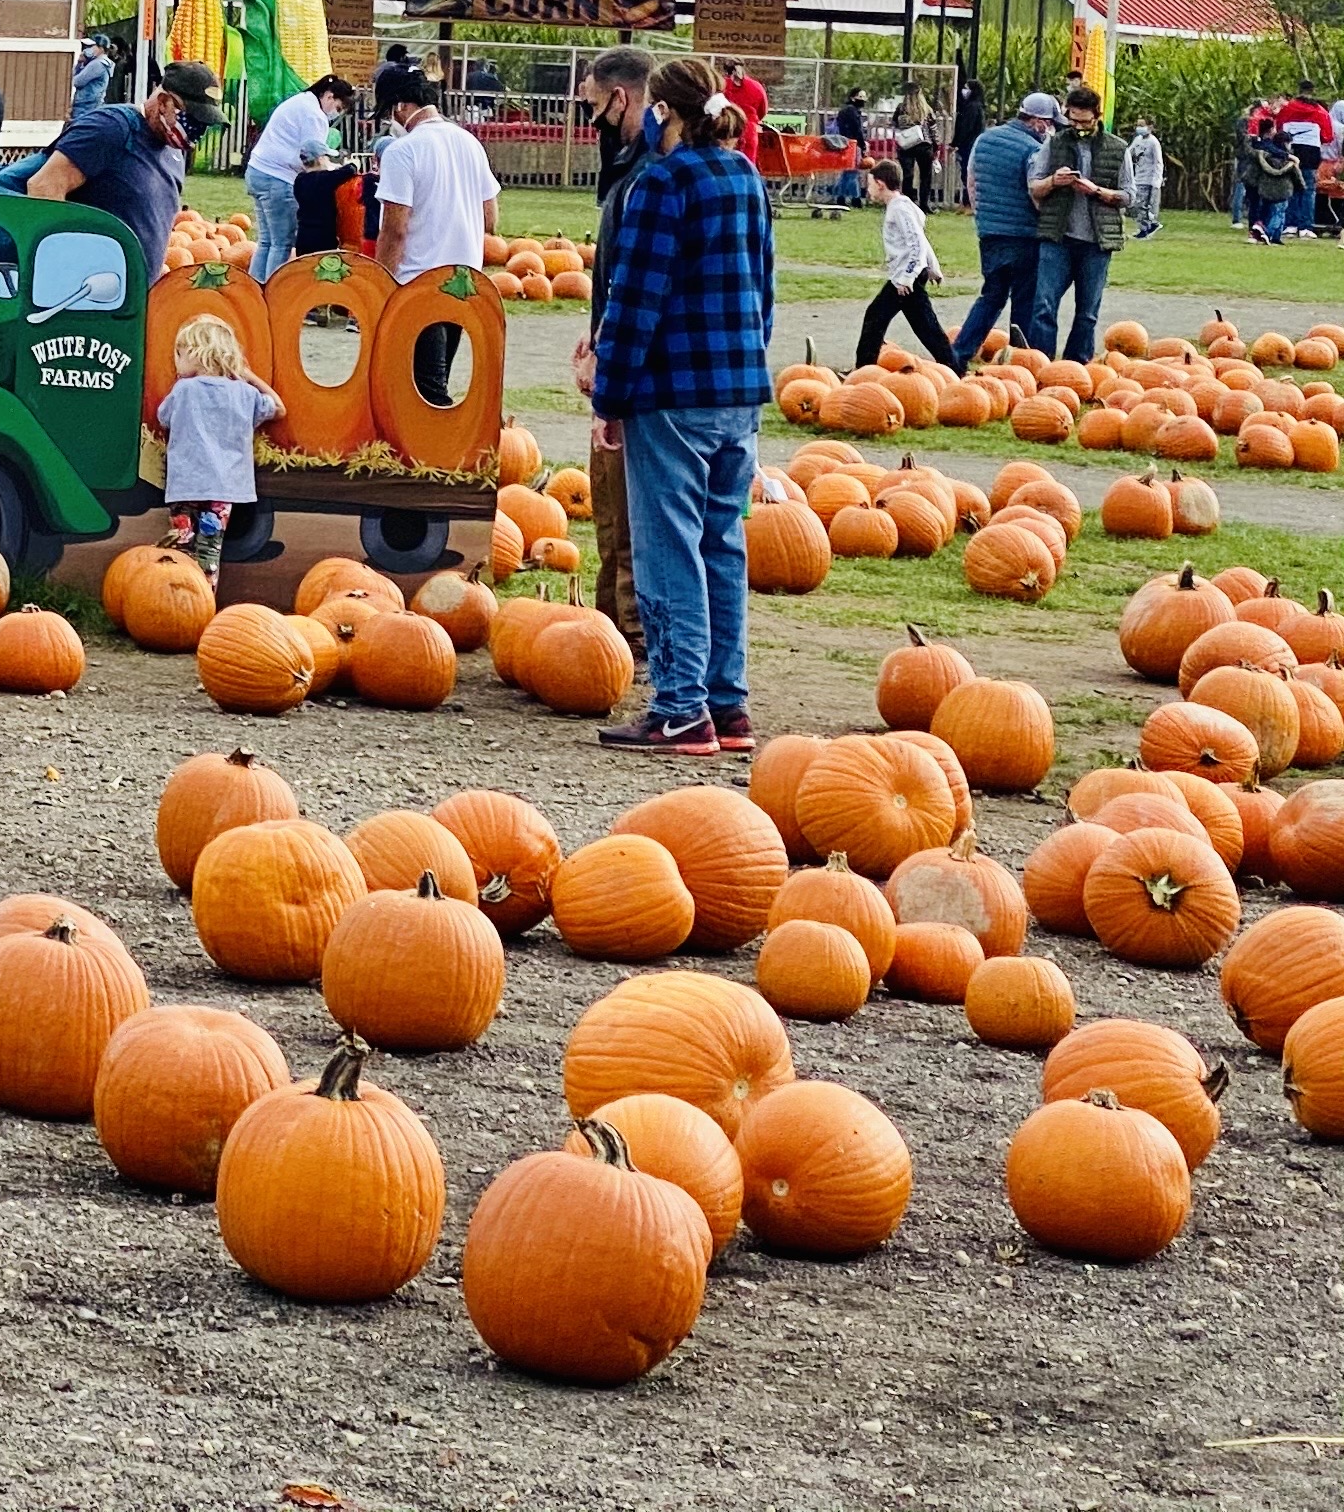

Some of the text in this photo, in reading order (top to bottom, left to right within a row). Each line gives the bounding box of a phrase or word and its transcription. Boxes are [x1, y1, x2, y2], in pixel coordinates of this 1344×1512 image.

[31, 336, 132, 375] WHITE POST
[40, 367, 115, 390] FARMS
